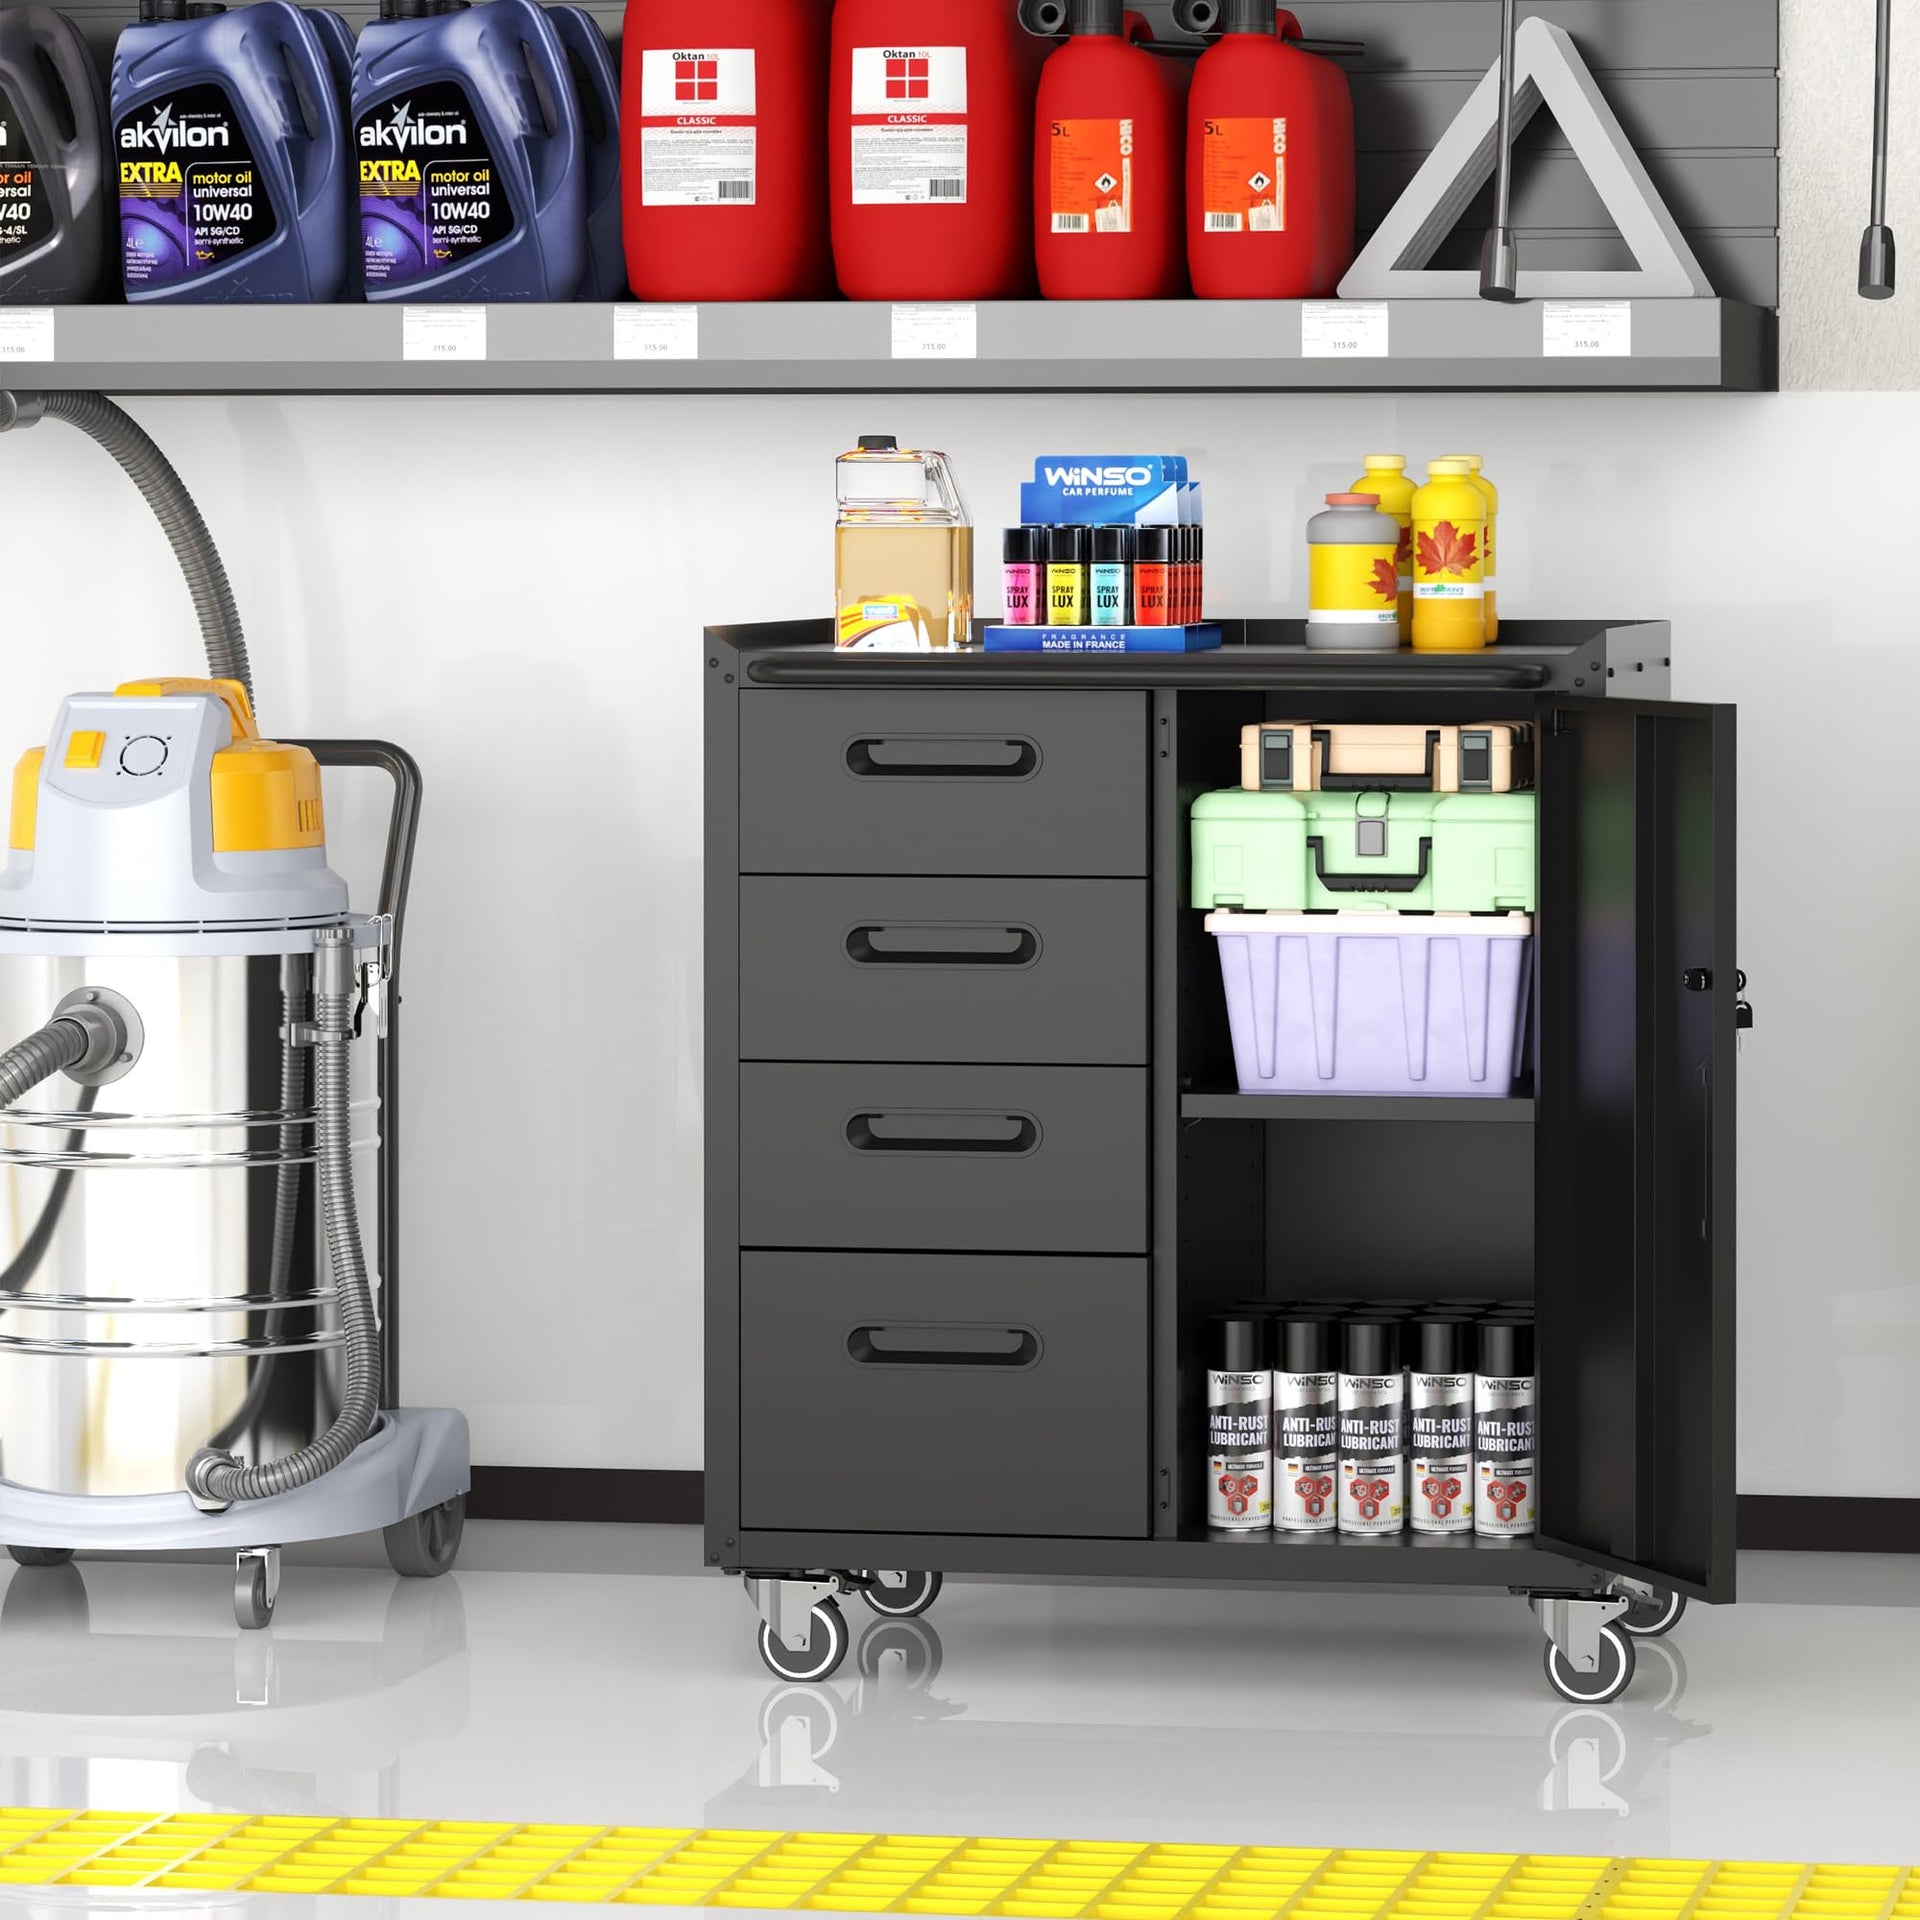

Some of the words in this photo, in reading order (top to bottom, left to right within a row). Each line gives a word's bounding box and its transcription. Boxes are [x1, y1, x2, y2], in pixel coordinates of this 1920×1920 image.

[672, 52, 705, 60] Oktan
[883, 50, 915, 58] Oktan
[677, 117, 716, 125] CLASSIC
[887, 115, 927, 123] CLASSIC
[1052, 123, 1061, 136] 5
[1063, 127, 1070, 137] L
[1204, 121, 1214, 135] 5
[1216, 125, 1223, 136] L
[121, 120, 229, 155] akvilon
[360, 118, 466, 153] akvilon
[120, 162, 183, 183] EXTRA
[360, 160, 421, 181] EXTRA
[431, 171, 469, 182] motor
[473, 169, 490, 181] oil
[14, 171, 31, 184] oil
[193, 173, 231, 184] motor
[236, 171, 252, 183] oil
[193, 185, 252, 198] universal
[431, 183, 490, 196] universal
[194, 203, 252, 221] 10W40
[431, 202, 490, 220] 10W40
[195, 227, 208, 236] API
[210, 226, 240, 236] SG/CD
[433, 226, 446, 235] API
[448, 225, 478, 235] SG/CD
[195, 238, 244, 246] semi-synthetic
[433, 236, 481, 245] semi-synthetic
[1063, 488, 1083, 496] CAR
[1085, 487, 1133, 496] PERFUME
[1006, 586, 1029, 594] SPRAY
[1007, 595, 1029, 608] LUX
[1052, 595, 1074, 608] LUX
[1097, 595, 1119, 608] LUX
[1141, 595, 1163, 608] LUX
[1042, 641, 1071, 649] MADE
[1085, 641, 1125, 649] FRANCE
[1210, 1415, 1268, 1430] ANTI-RUST
[1283, 1416, 1336, 1432] ANTI-RUS
[1341, 1419, 1400, 1434] ANTI-RUST
[1413, 1417, 1471, 1433] ANTI-RUST
[1210, 1431, 1268, 1446] LUBRICANT
[1283, 1432, 1336, 1448] LUBRICAN
[1341, 1435, 1399, 1450] LUBRICANT
[1413, 1434, 1470, 1449] LUBRICANT
